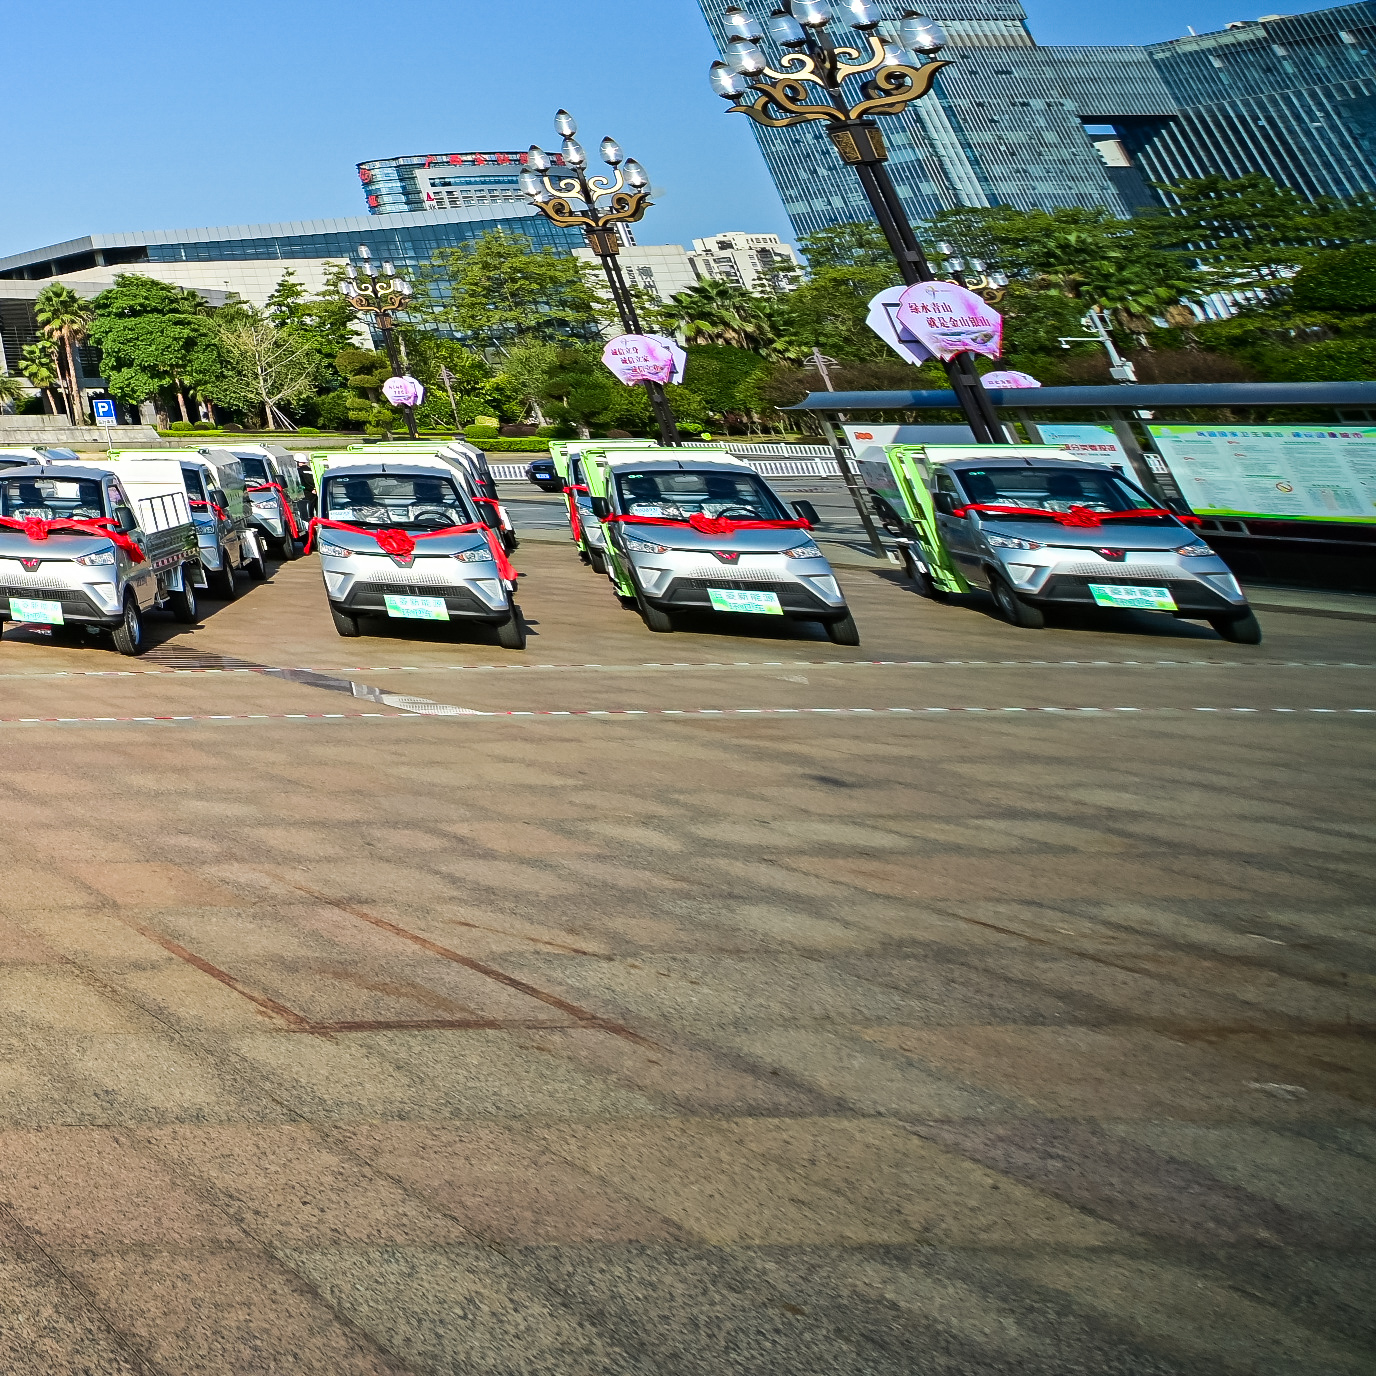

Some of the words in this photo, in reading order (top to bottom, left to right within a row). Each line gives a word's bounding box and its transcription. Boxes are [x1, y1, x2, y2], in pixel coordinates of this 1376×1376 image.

[908, 302, 953, 314] 绿水青山
[926, 316, 992, 329] 就是金山银山
[97, 402, 109, 417] P
